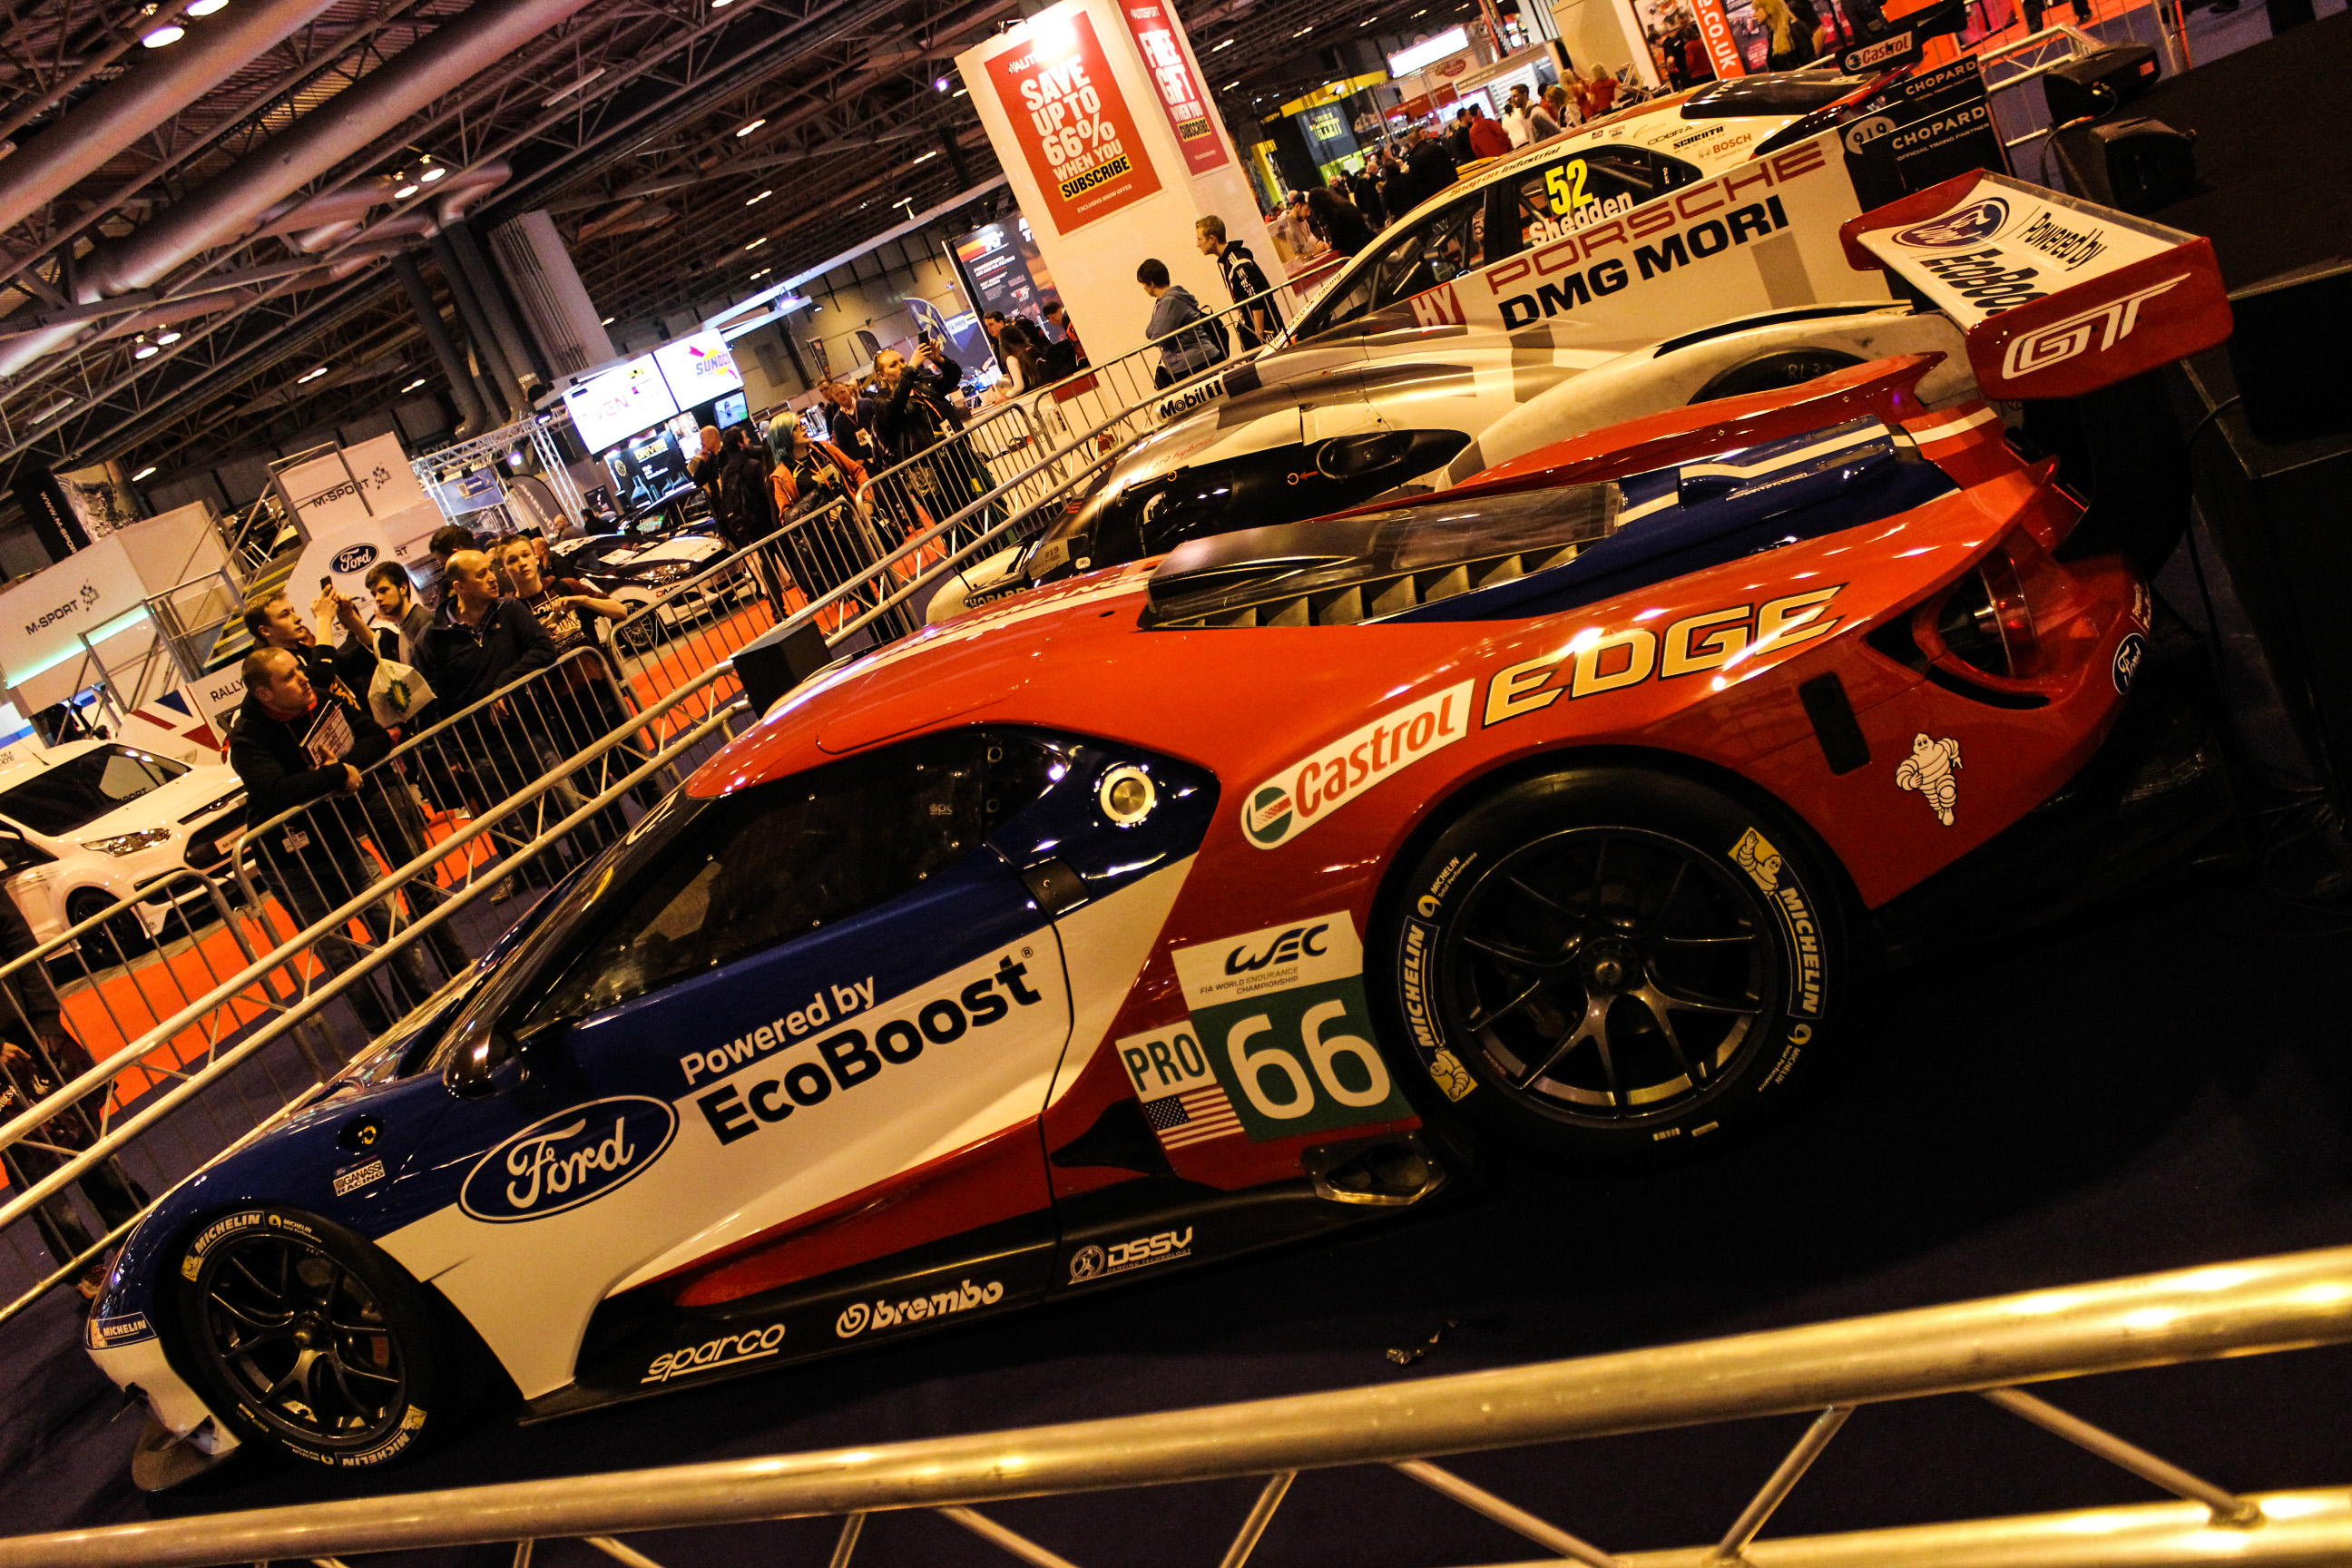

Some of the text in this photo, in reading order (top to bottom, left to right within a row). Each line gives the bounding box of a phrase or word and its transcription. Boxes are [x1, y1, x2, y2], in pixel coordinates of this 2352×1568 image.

[1138, 29, 1182, 68] FREE
[1862, 35, 1909, 65] Castrol
[1020, 54, 1091, 111] SAVE
[1155, 64, 1195, 106] GIFT
[1906, 61, 1976, 96] CHOPARD
[1031, 85, 1102, 137] UP TO
[1170, 100, 1204, 122] WHEN YOU
[1179, 119, 1210, 139] SUBSCRIBE
[1892, 106, 1985, 150] CHOPARD
[1042, 112, 1116, 166] 66%
[1648, 125, 1693, 145] COBRA
[1713, 133, 1752, 154] BOSCH
[1896, 122, 1990, 162] OFFICIAL TIMING PARTNER
[1053, 138, 1123, 182] WHEN YOU
[1061, 155, 1131, 198] SUBSCRIBE
[1501, 146, 1562, 174] Industrial
[1076, 183, 1132, 213] EXCLUSIVE SHOW OFFER
[1545, 158, 1593, 215] 52
[1486, 140, 1826, 295] PORSCHE
[1529, 191, 1633, 247] Shedden
[1498, 193, 1790, 331] DMG MORI
[2017, 211, 2108, 271] Powered by
[1410, 282, 1458, 327] HY
[1919, 249, 2051, 318] EcoBoo
[2002, 273, 2192, 380] GT
[695, 352, 732, 376] SUNOCO
[1160, 387, 1207, 419] Mobil
[1171, 435, 1214, 460] hybrid
[339, 547, 372, 573] Ford
[24, 600, 79, 635] M-SPORT
[1481, 582, 1850, 729] EDGE
[210, 679, 245, 702] RALLY
[1295, 693, 1456, 818] Castrol
[1431, 857, 1460, 895] MICHELIN
[1438, 852, 1478, 898] Total Performance
[1225, 923, 1329, 975] WEC
[1779, 887, 1819, 1014] MICHELIN
[1200, 966, 1298, 995] FIA WORLD ENDURANCE
[1237, 975, 1298, 995] CHAMPIONSHIP
[1404, 925, 1435, 1047] MICHELIN
[680, 975, 877, 1085] Powered by
[1122, 1033, 1206, 1093] PRO
[1227, 999, 1390, 1120] 66
[1774, 1047, 1801, 1084] MICHELIN
[337, 1171, 384, 1195] RACING
[344, 1162, 382, 1185] GANASSI
[505, 1117, 636, 1209] Ford
[193, 1213, 261, 1255] MICHELIN
[283, 1219, 313, 1234] MICHELIN
[1107, 1226, 1193, 1268] DSSV
[1142, 1249, 1191, 1265] TECHNOLOGY
[871, 1279, 1004, 1331] brembo
[103, 1319, 147, 1337] MICHELIN
[641, 1324, 786, 1383] sparco
[342, 1431, 411, 1467] MICHELIN
